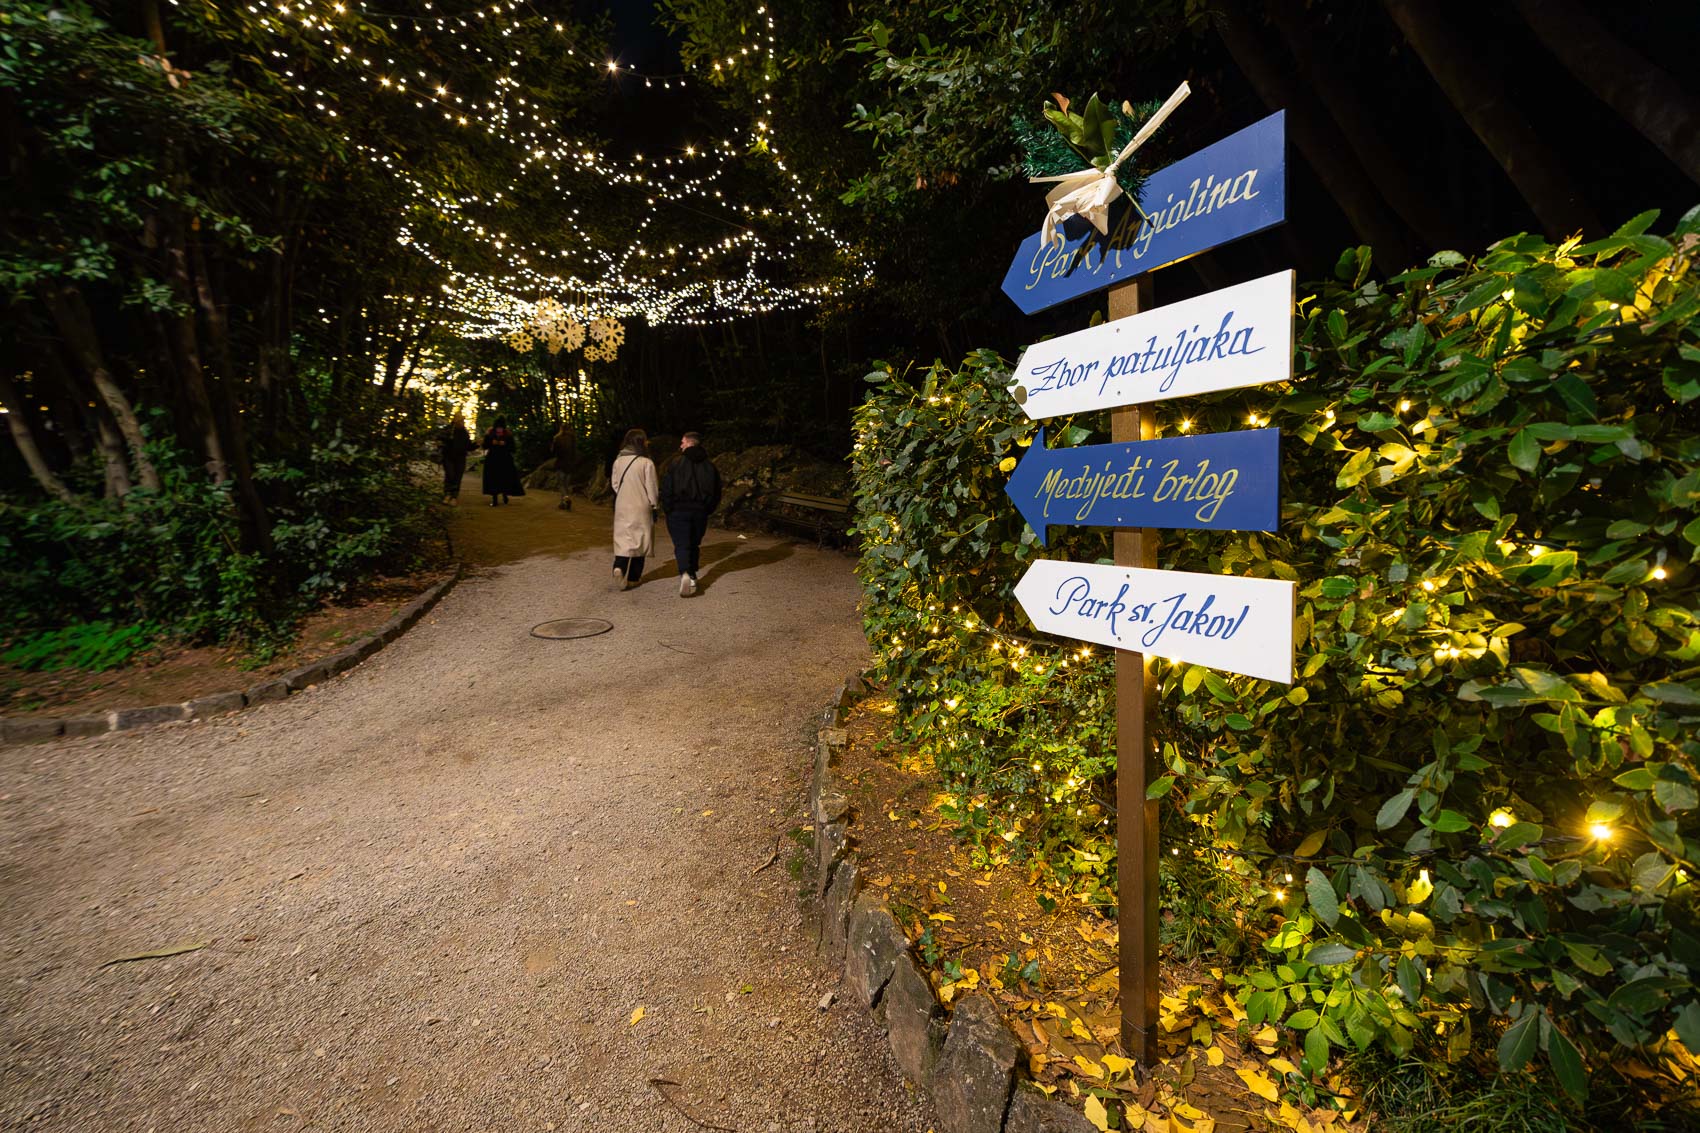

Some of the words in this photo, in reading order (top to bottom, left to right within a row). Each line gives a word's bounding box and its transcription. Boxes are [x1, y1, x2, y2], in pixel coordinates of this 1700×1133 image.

[1025, 227, 1098, 291] Park
[1093, 168, 1260, 275] Angiolina
[1028, 357, 1099, 397] Zbor
[1098, 310, 1266, 396] patuljaka
[1152, 458, 1239, 523] brlog
[1049, 576, 1130, 636] Park
[1127, 600, 1157, 624] sv.
[1141, 592, 1250, 648] Jakov
